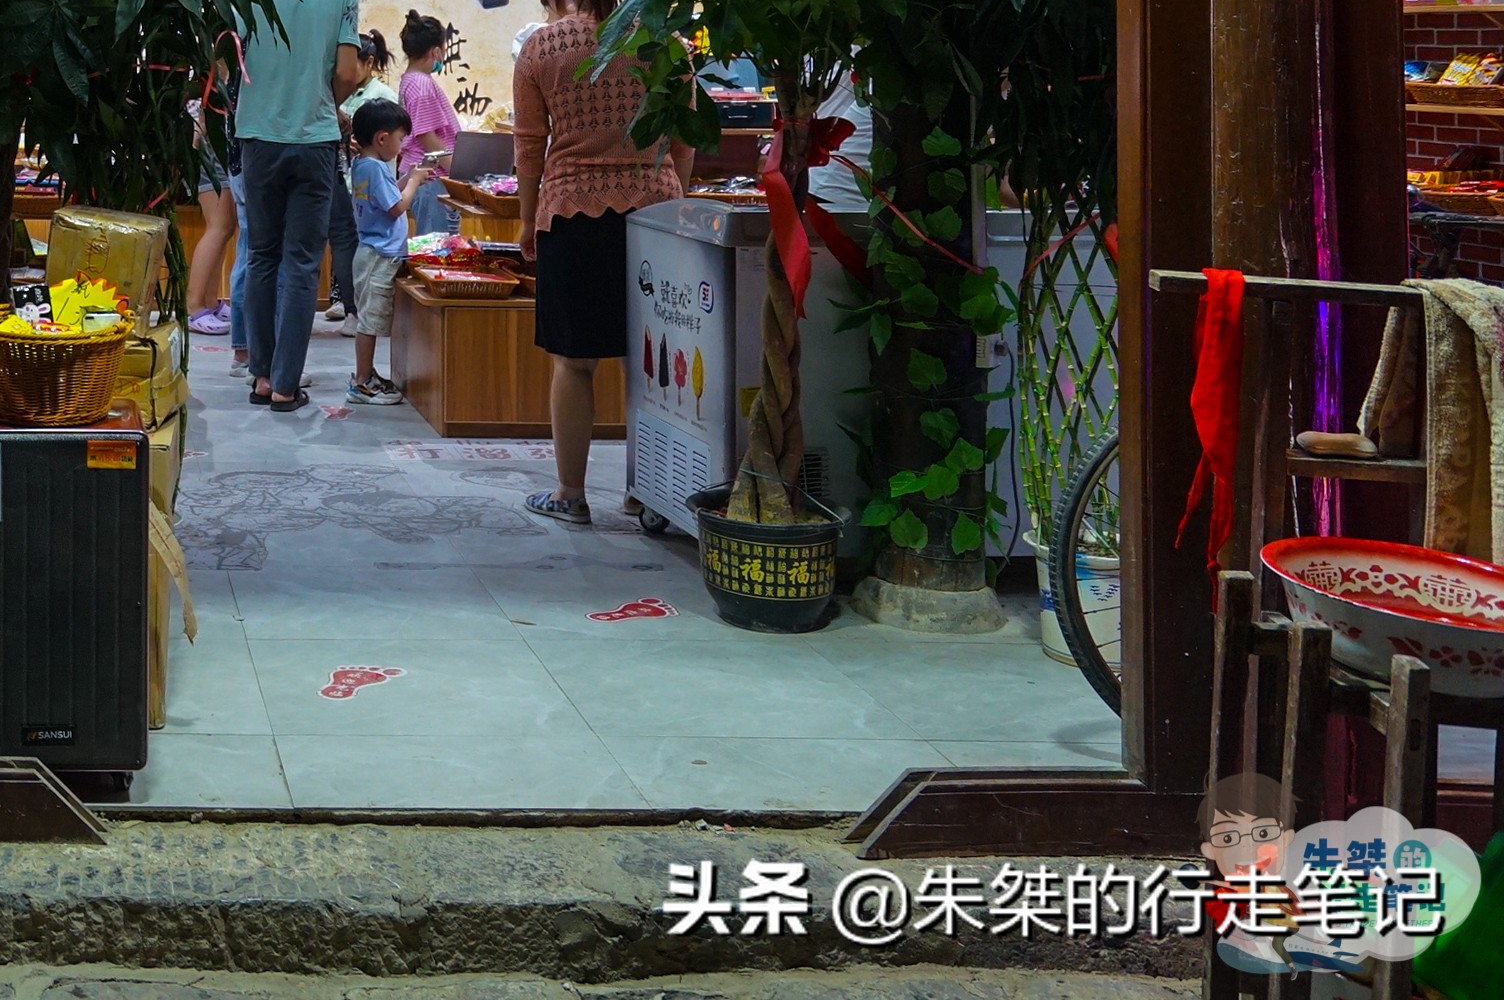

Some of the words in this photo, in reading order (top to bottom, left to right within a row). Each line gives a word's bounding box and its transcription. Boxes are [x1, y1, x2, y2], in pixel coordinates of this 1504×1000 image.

[739, 557, 765, 584] 福
[787, 560, 811, 585] 福
[37, 730, 73, 740] SANSUI
